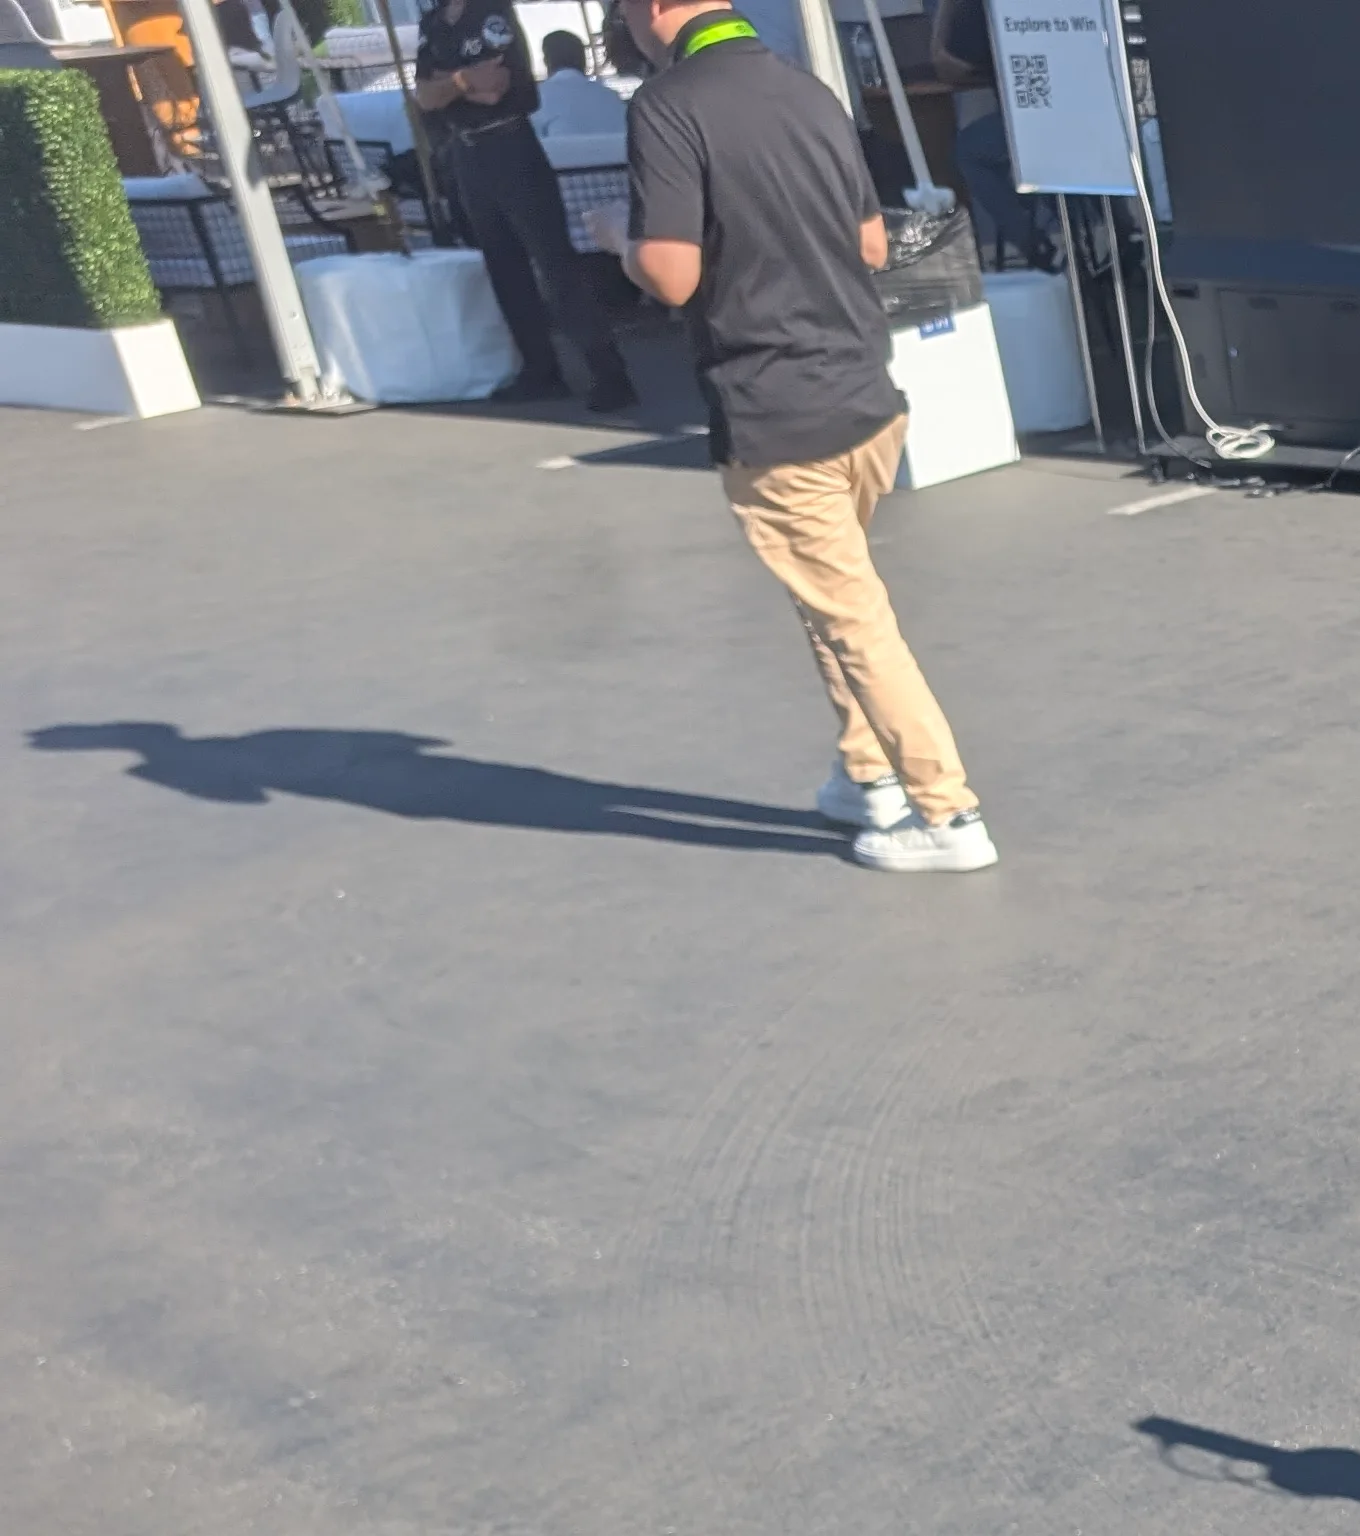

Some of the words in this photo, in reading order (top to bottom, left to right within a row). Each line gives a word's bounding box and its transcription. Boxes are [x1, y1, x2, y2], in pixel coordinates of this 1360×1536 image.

[1004, 16, 1052, 34] Explore
[1053, 18, 1069, 31] to
[1069, 16, 1097, 31] Win
